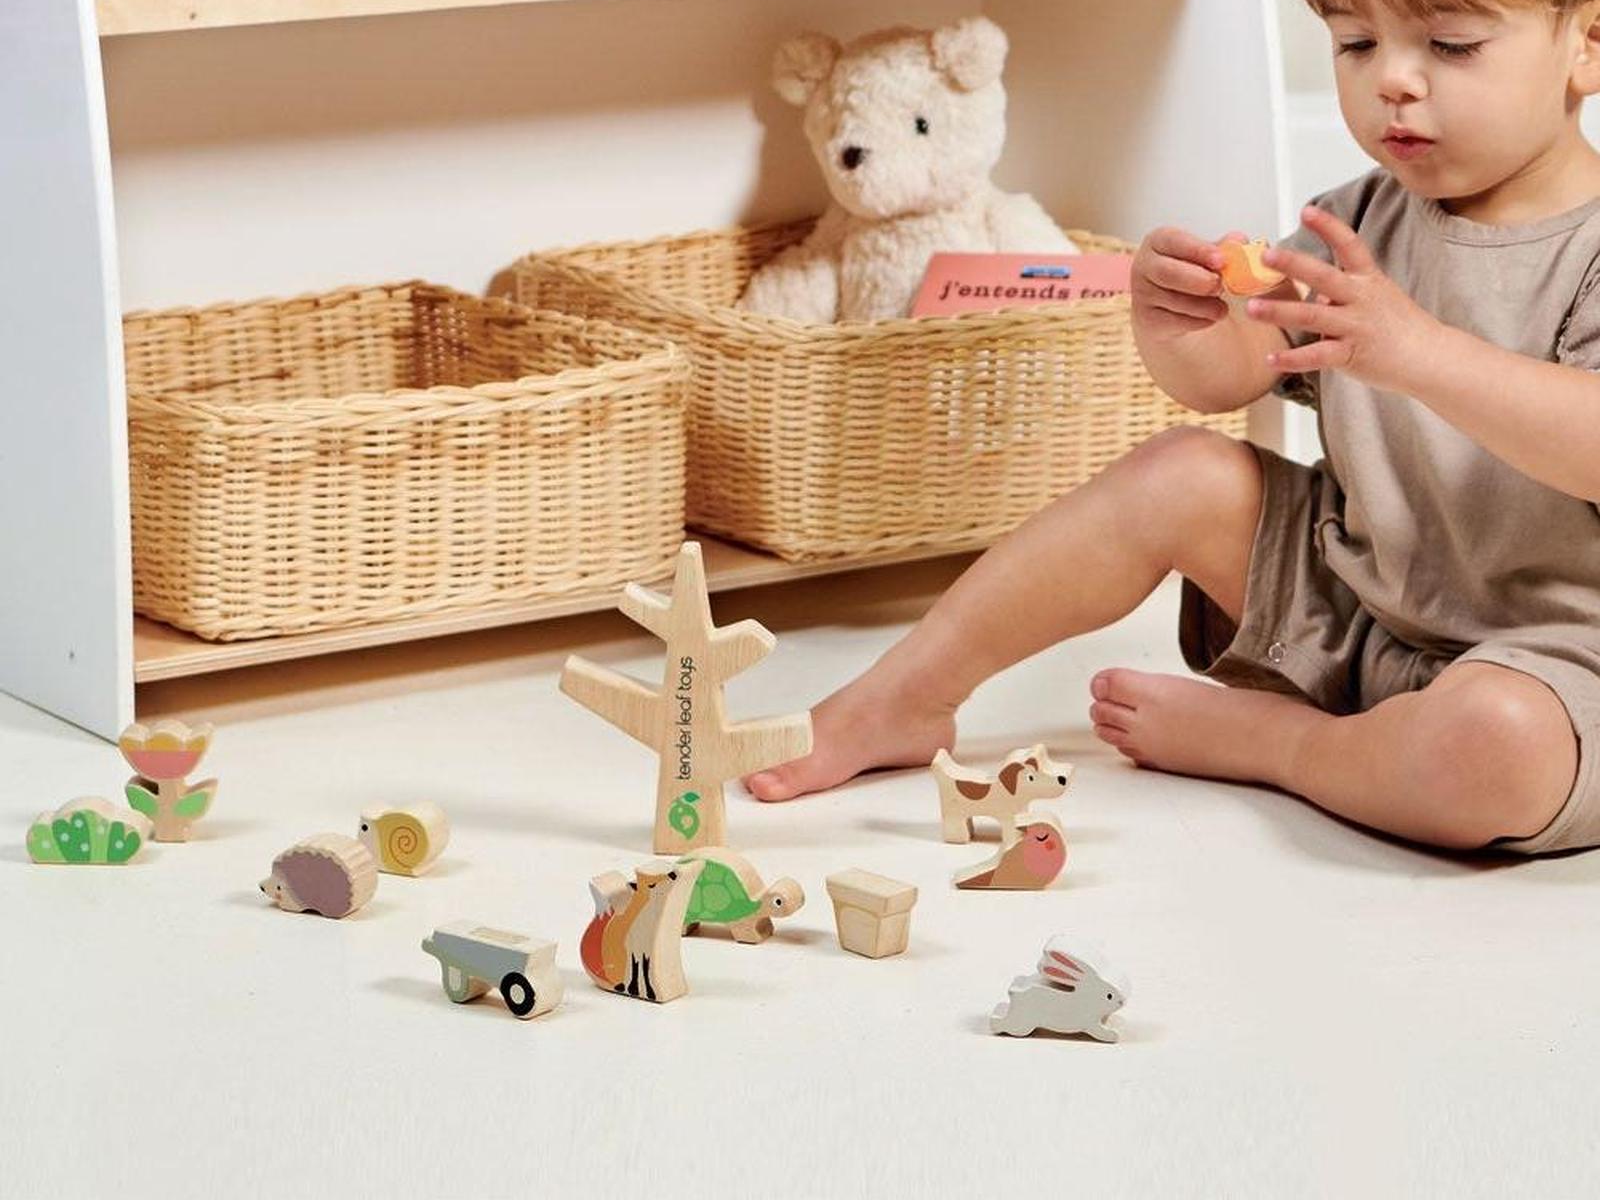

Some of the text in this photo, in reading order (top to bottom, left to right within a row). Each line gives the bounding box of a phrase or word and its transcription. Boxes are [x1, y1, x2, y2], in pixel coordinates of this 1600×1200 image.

[939, 280, 1071, 301] j'entends
[675, 656, 697, 780] tender leaf toys
